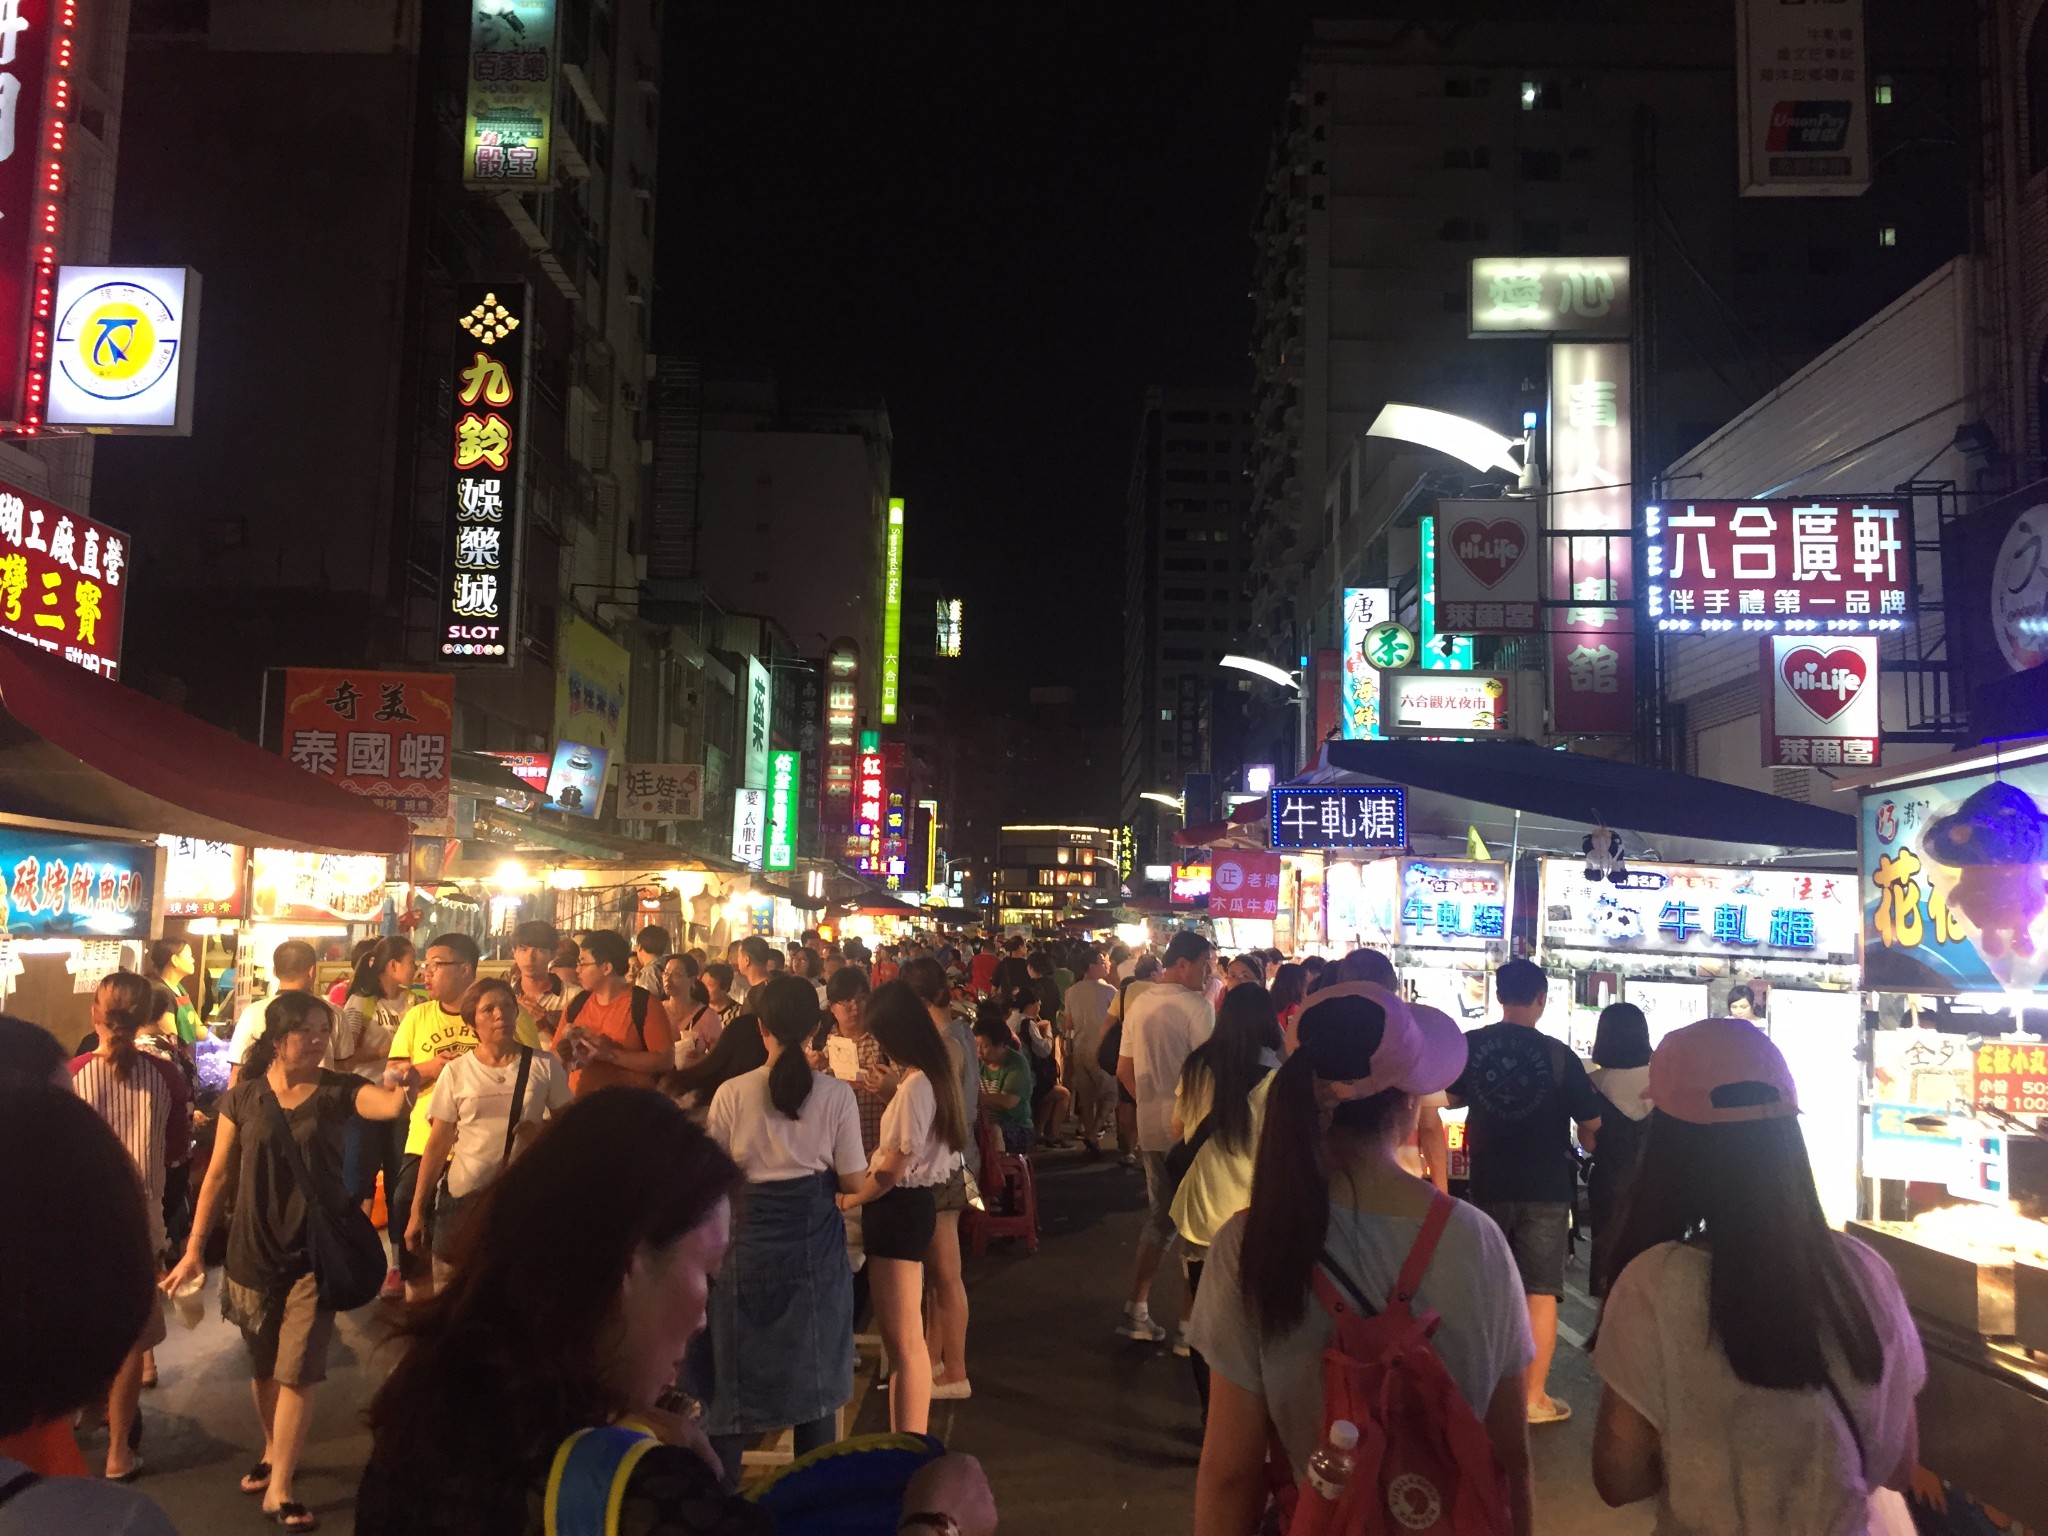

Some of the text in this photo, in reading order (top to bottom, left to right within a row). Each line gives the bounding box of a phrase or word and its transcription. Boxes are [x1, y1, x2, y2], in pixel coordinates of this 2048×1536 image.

[1773, 113, 1848, 128] UnionPay
[455, 352, 514, 617] 九鈴娛樂城
[1460, 533, 1519, 569] Hi-Life
[1667, 504, 1902, 582] 六合廣軒
[888, 578, 900, 604] Hotel
[1668, 588, 1907, 615] 伴手禮第一品牌
[1445, 603, 1534, 629] 萊爾富
[448, 625, 501, 640] SLOT
[1793, 662, 1862, 701] Hi-Life
[326, 679, 419, 722] 奇美
[1400, 694, 1487, 710] 六合觀光夜市
[291, 730, 445, 780] 泰國蝦
[1779, 738, 1874, 764] 萊爾富
[625, 769, 678, 799] 娃娃
[743, 790, 760, 844] 愛衣服
[1281, 796, 1396, 839] 牛軋糖
[1221, 868, 1239, 885] 正
[1247, 873, 1279, 888] 老牌
[169, 901, 232, 914] 現烤 現煮
[1211, 897, 1278, 914] 木瓜牛奶
[1402, 898, 1505, 938] 牛軋糖
[1657, 899, 1817, 950] 牛軋糖
[1977, 1045, 2047, 1075] 花枝小丸
